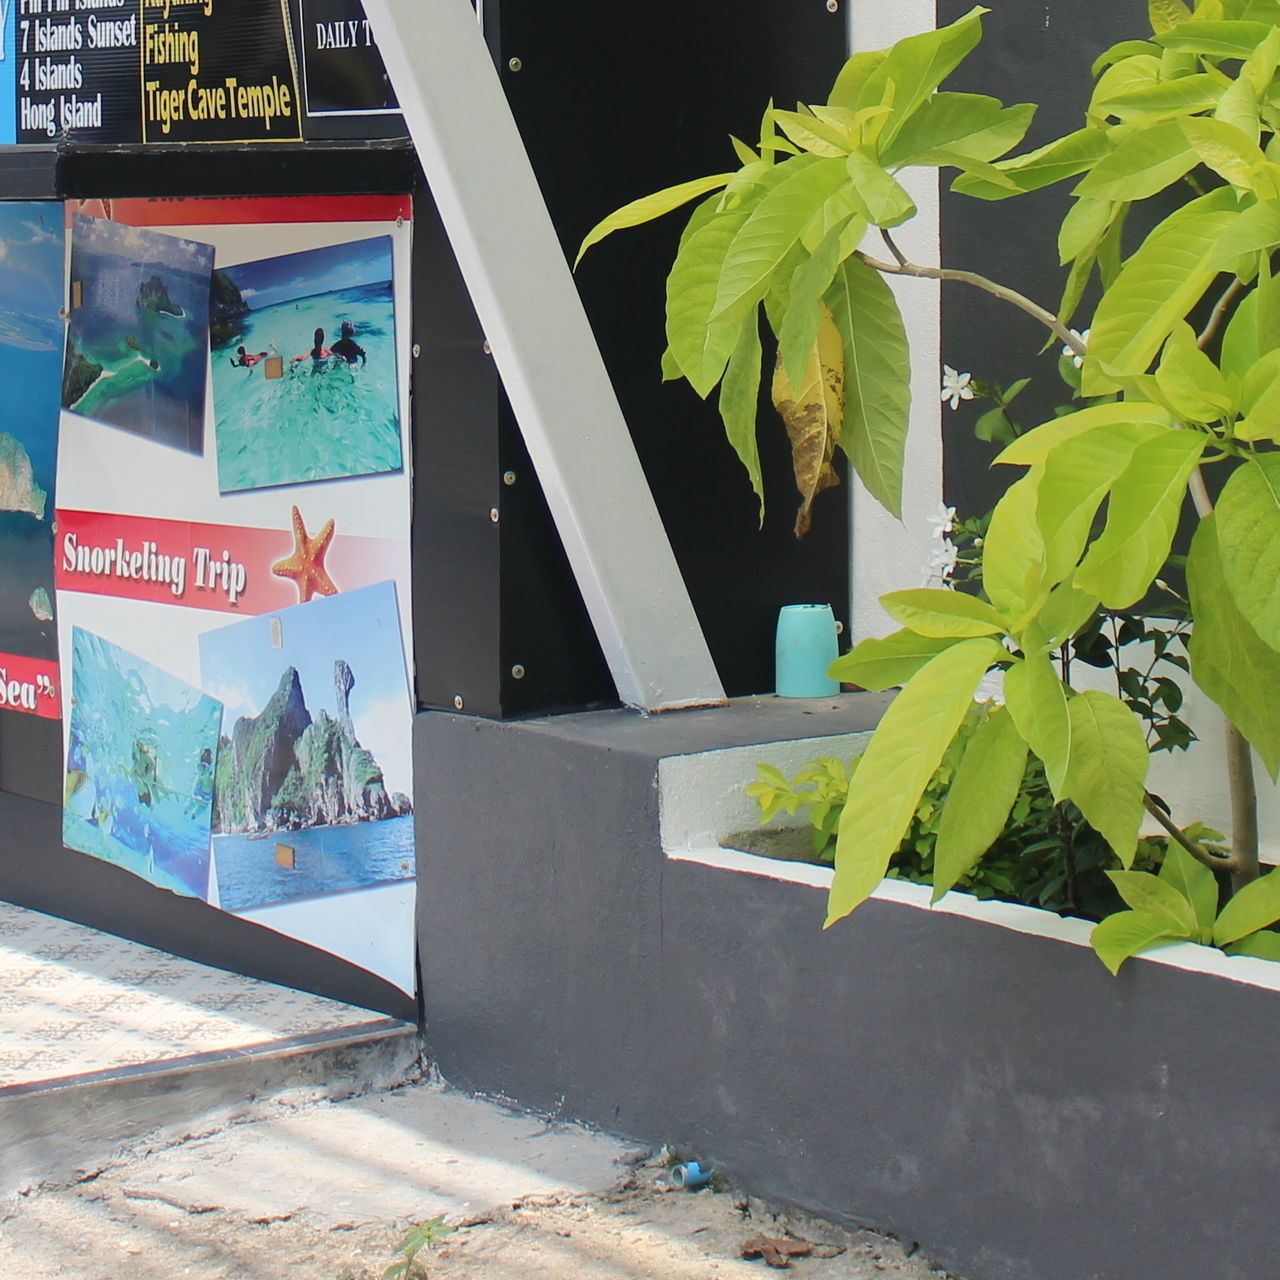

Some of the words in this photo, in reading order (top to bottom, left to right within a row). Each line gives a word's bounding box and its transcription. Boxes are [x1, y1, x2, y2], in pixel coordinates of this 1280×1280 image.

[20, 19, 30, 53] 7
[34, 15, 83, 53] Islands
[87, 12, 137, 49] Sunset
[145, 22, 199, 76] Fishing
[315, 20, 359, 50] DAILY
[20, 58, 30, 91] 4
[34, 54, 83, 91] Islands
[21, 96, 57, 138] Hong
[59, 91, 102, 129] Island
[146, 80, 185, 134] Tiger
[187, 78, 226, 121] Cave
[225, 75, 291, 131] Temple
[62, 532, 186, 596] Snorkeling
[192, 546, 248, 604] Trip
